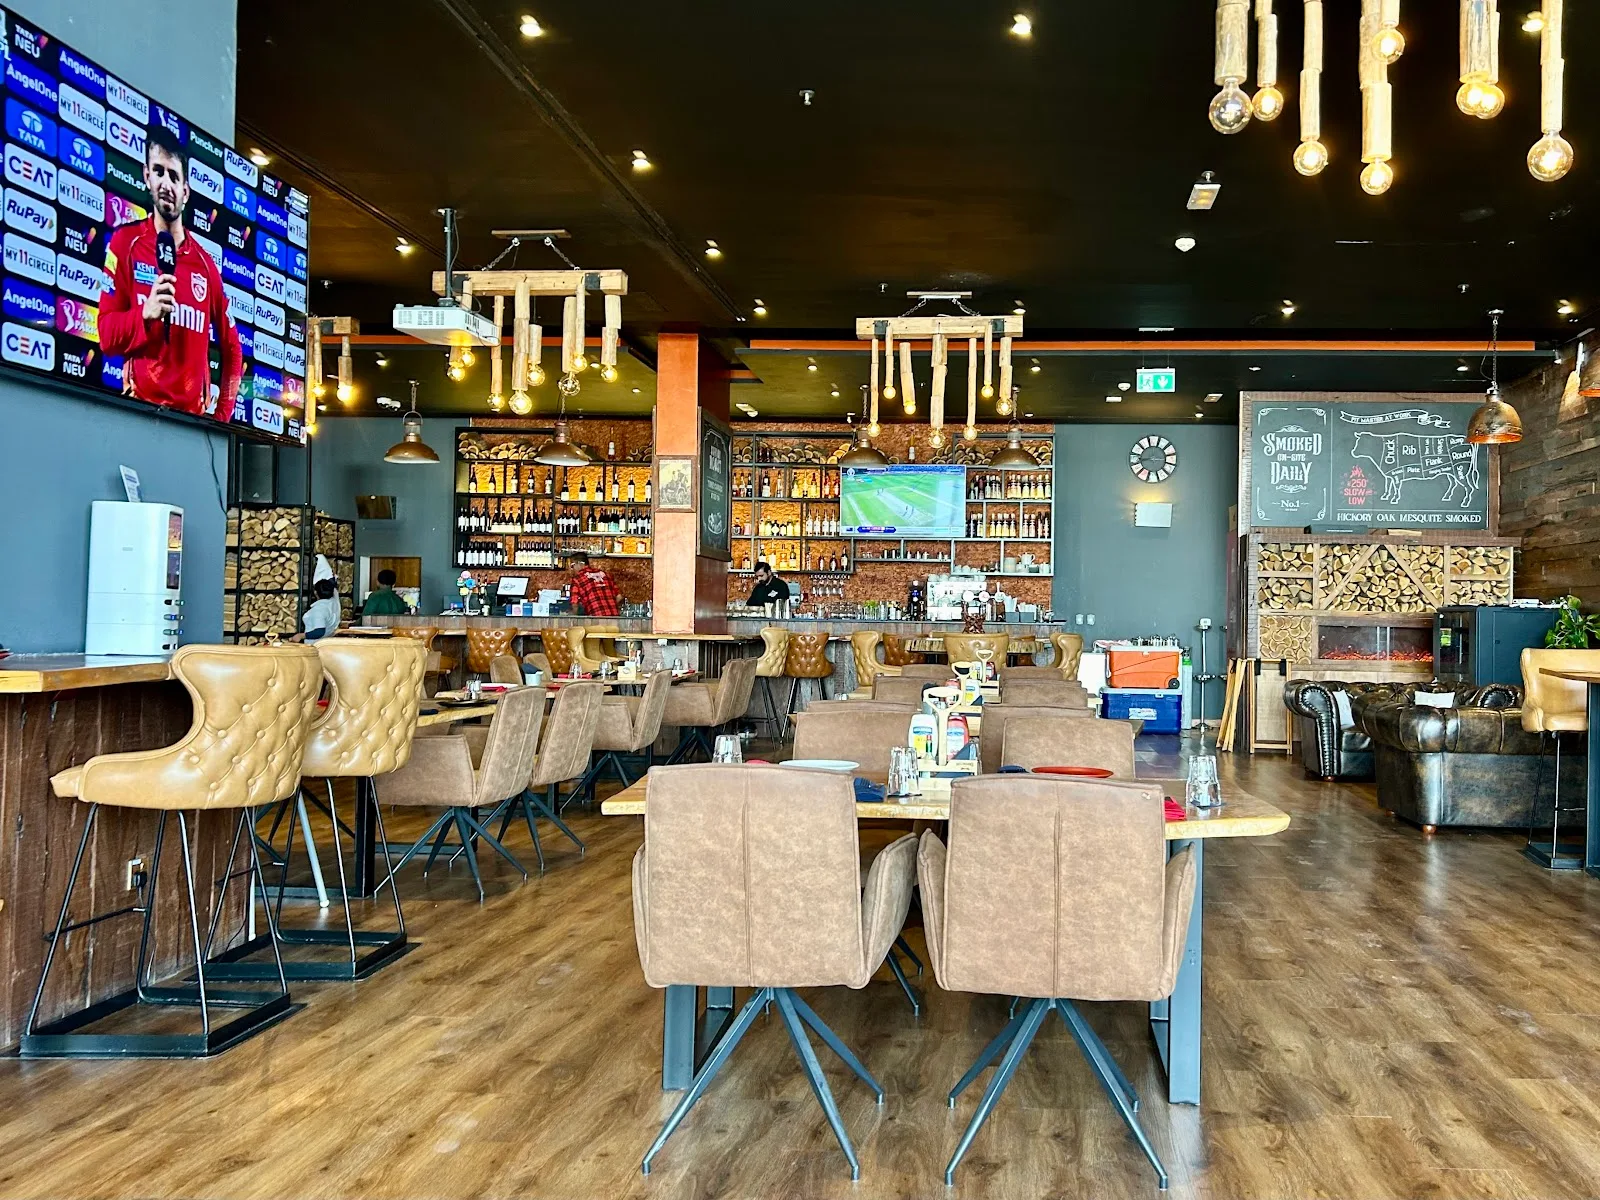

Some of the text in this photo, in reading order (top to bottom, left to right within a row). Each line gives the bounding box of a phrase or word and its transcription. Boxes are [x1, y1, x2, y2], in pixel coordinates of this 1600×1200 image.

[15, 34, 40, 58] NEU
[60, 50, 105, 88] AngelOne
[6, 63, 58, 102] AngelOne
[18, 128, 46, 151] TATA
[109, 122, 147, 154] CEAT
[9, 155, 53, 189] CEAT
[69, 154, 95, 175] TATA
[226, 151, 253, 176] RuPay
[107, 162, 146, 191] Punch.ev
[190, 166, 219, 193] RuPay
[262, 181, 278, 197] NEU
[7, 199, 48, 229] RuPay
[231, 201, 249, 217] TATA
[257, 205, 288, 229] AngelOne
[193, 216, 211, 233] NEU
[65, 235, 88, 254] NEU
[228, 233, 245, 249] NEU
[136, 261, 156, 275] KENT
[223, 256, 255, 280] AngelOne
[263, 251, 279, 267] TATA
[58, 263, 96, 290] RuPay
[257, 272, 284, 295] CEAT
[3, 288, 55, 316] AngelOne
[231, 295, 253, 315] 11CIRCLE
[256, 305, 281, 327] RuPay
[289, 329, 304, 342] NEU
[6, 333, 51, 360] CEAT
[286, 350, 305, 367] RuPa
[63, 361, 86, 377] NEU
[253, 372, 284, 392] AngelOne
[234, 406, 247, 422] IPL
[255, 406, 281, 427] CEAT
[1394, 411, 1411, 419] WORK
[1261, 433, 1322, 456] SMOKED
[1385, 440, 1395, 464] Chuck
[1402, 445, 1417, 456] Rib
[1451, 449, 1472, 460] Round
[1277, 453, 1306, 462] ON-SITE
[1425, 456, 1443, 467] Flank
[1270, 461, 1312, 485] DAILY
[1343, 488, 1366, 497] SLOW
[1348, 496, 1366, 505] LOW
[1280, 500, 1301, 508] No.1
[1337, 512, 1482, 524] HICKORY OAK MESQUITE SMOKED
